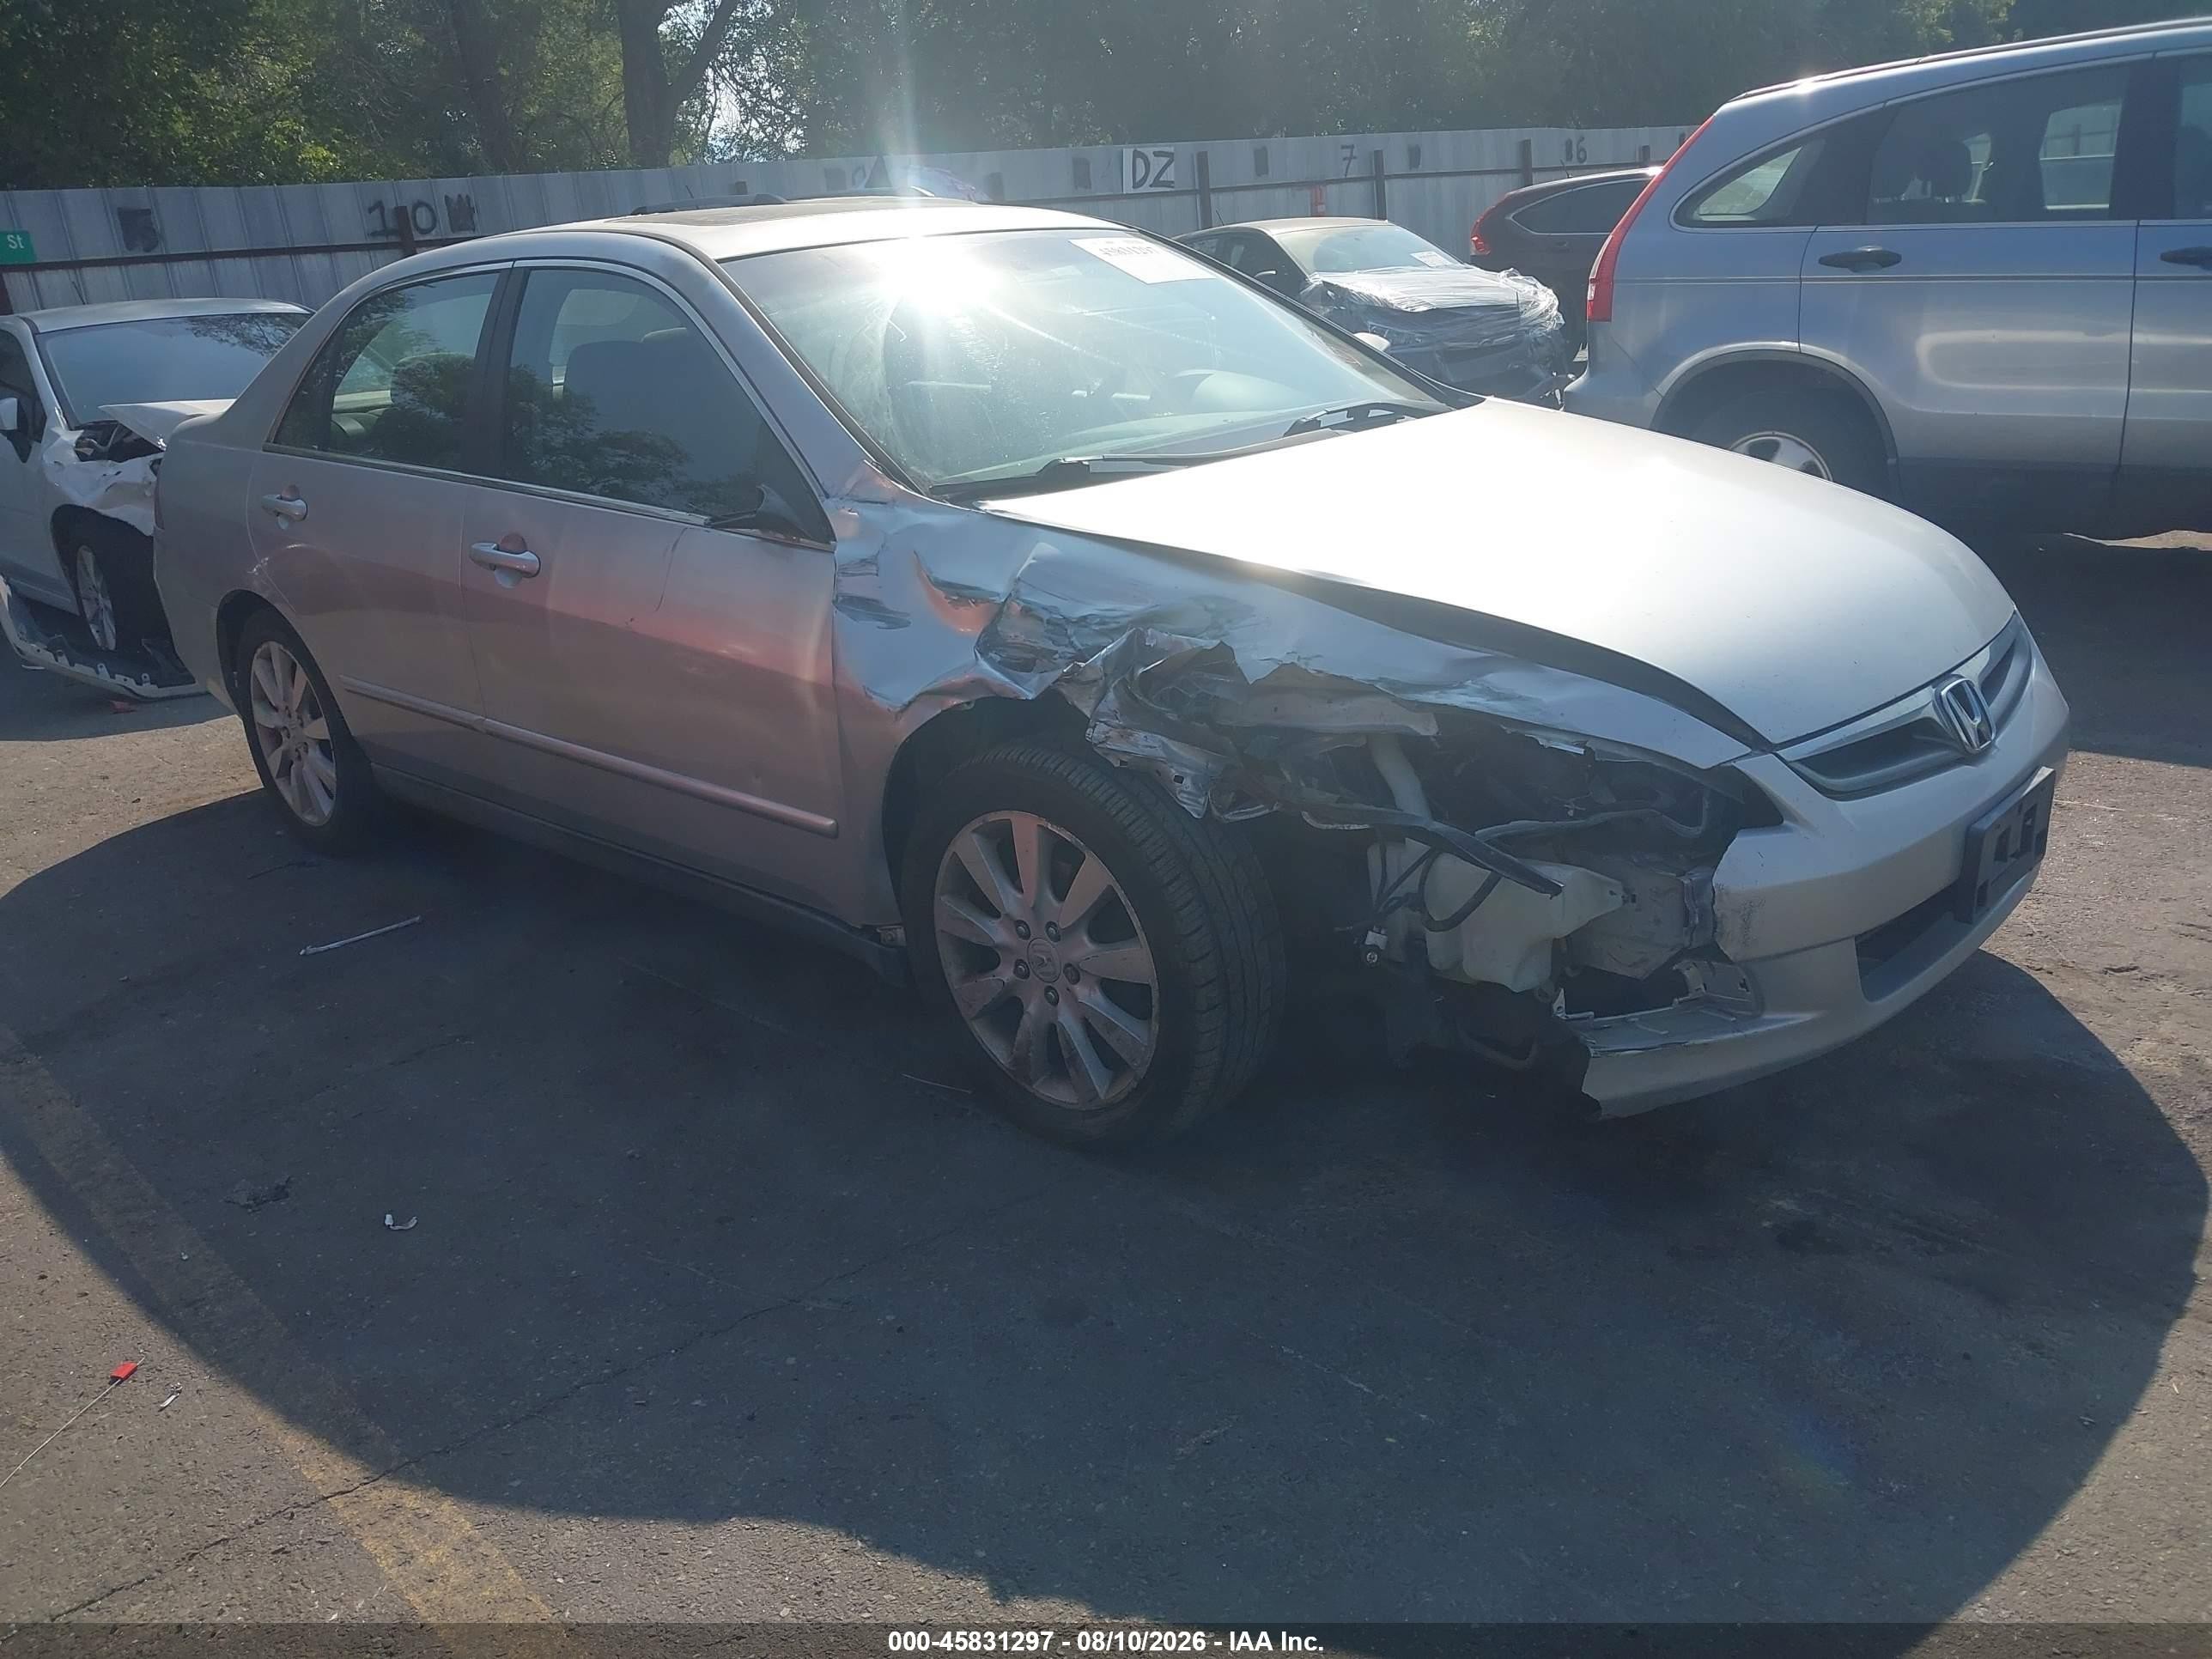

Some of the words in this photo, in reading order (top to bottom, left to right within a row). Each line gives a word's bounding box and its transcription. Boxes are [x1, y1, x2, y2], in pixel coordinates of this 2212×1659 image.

[1132, 149, 1175, 189] DZ
[1340, 144, 1357, 178] 7
[7, 234, 25, 249] St
